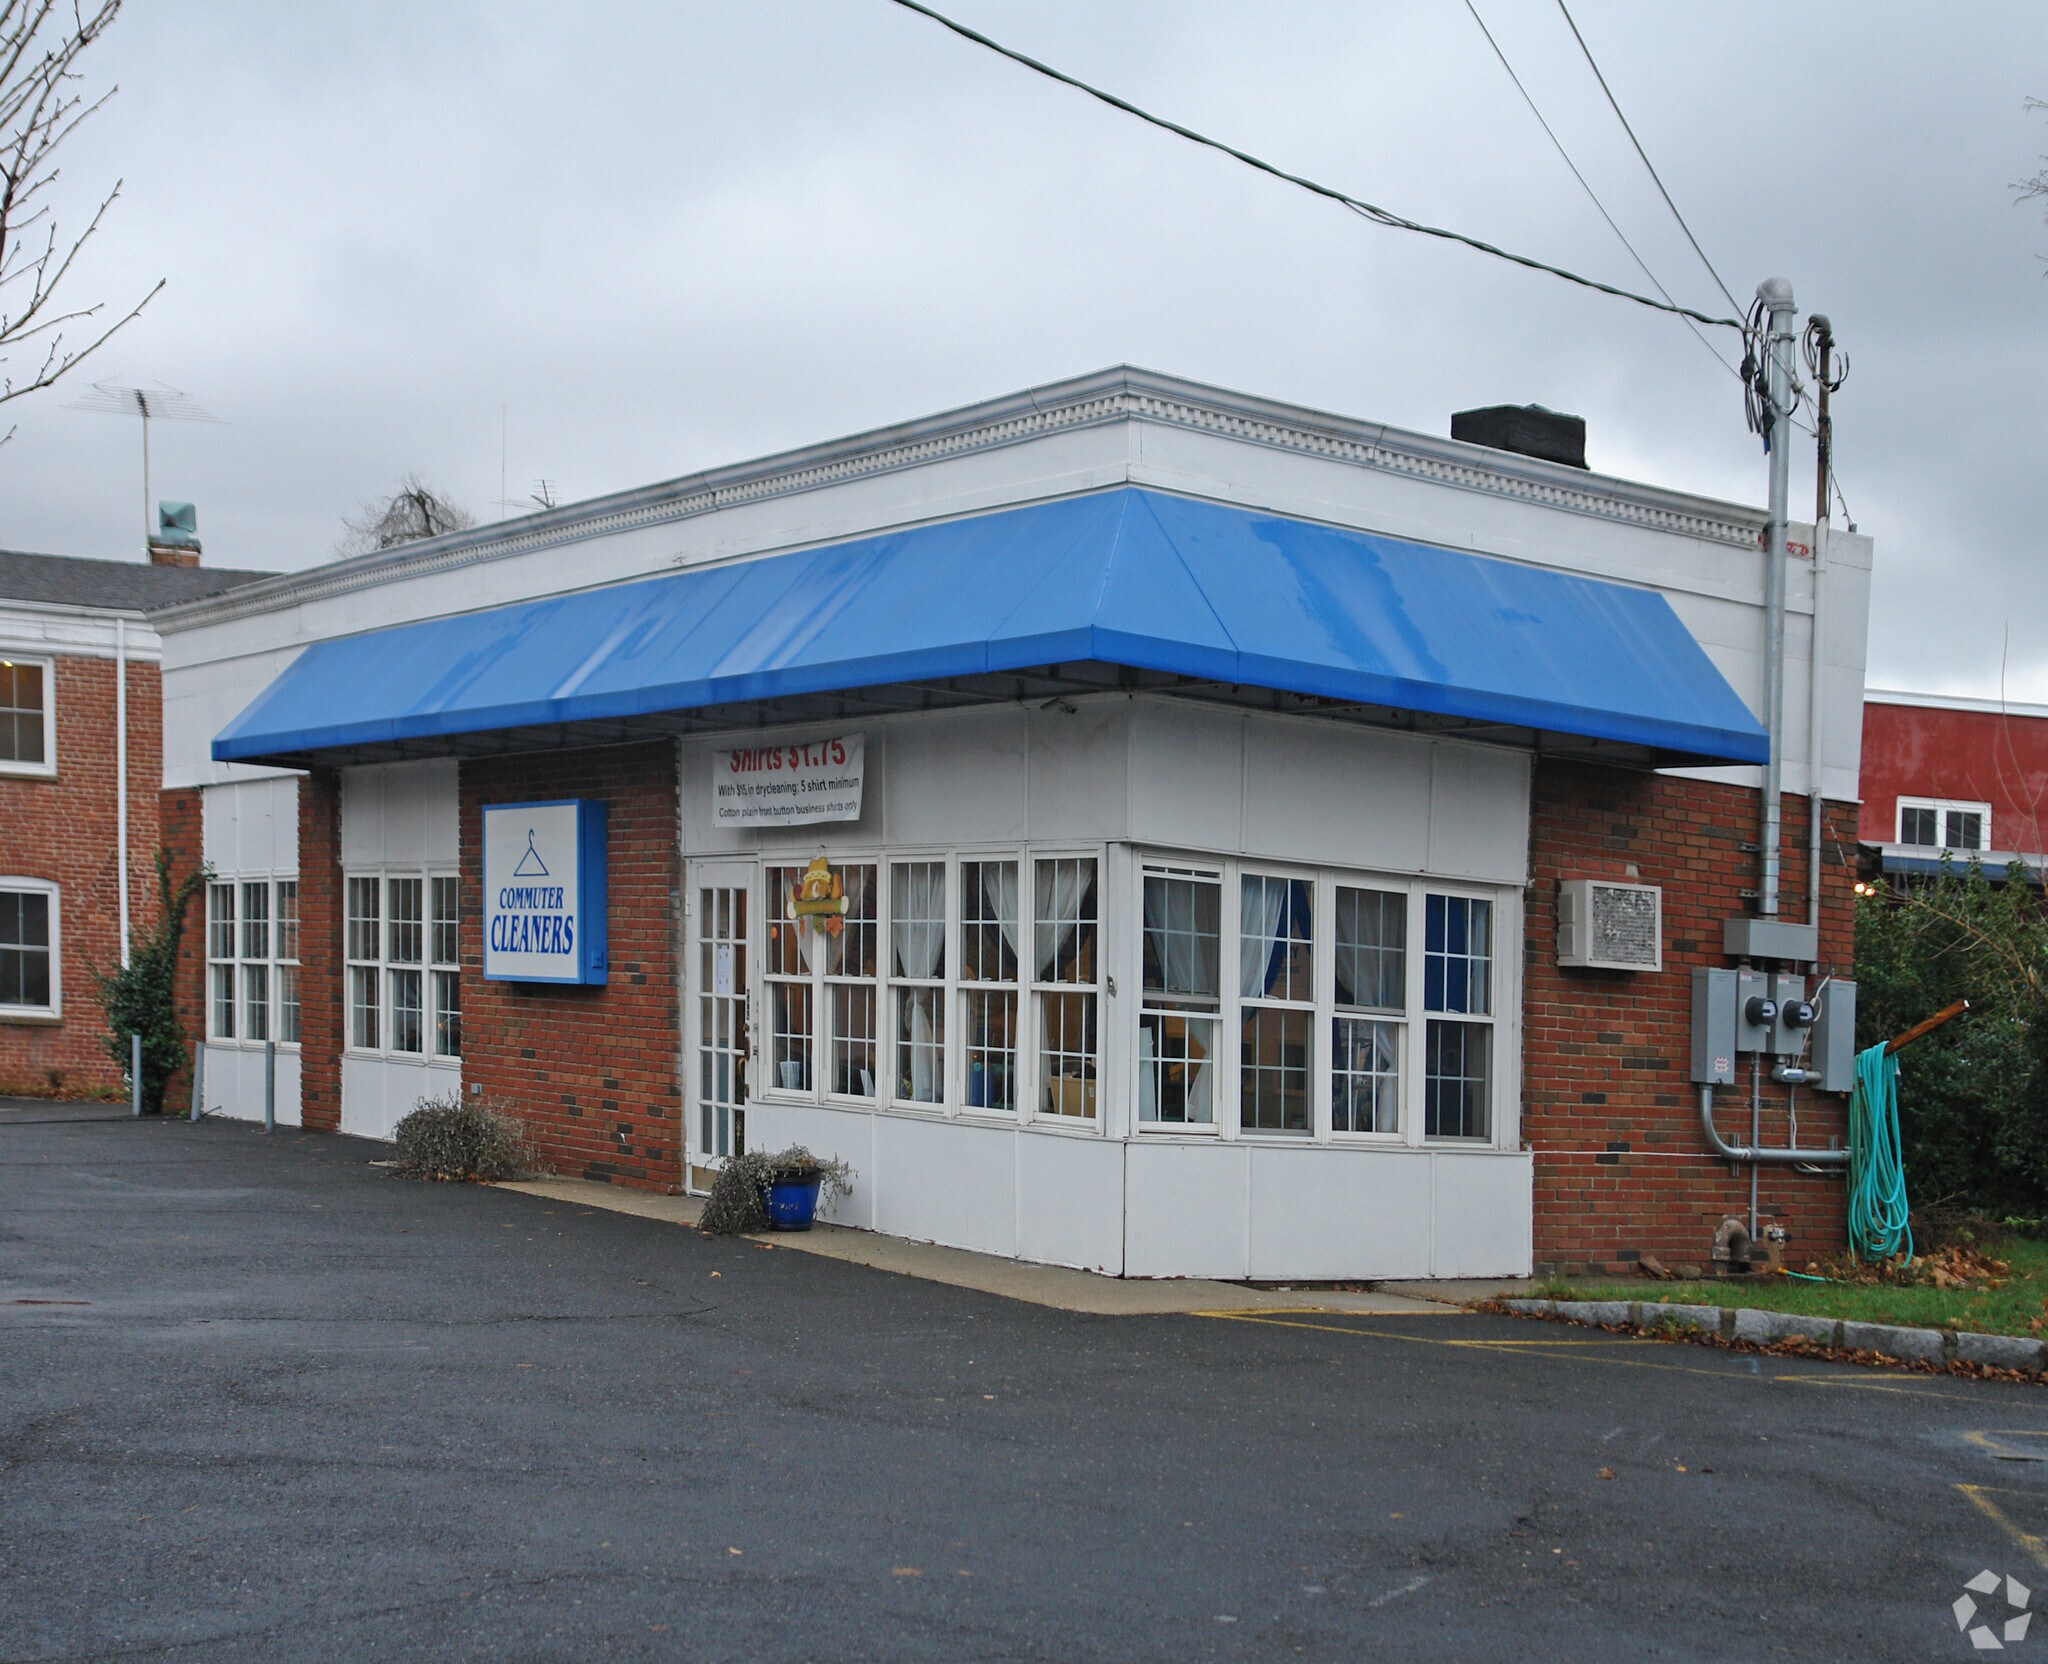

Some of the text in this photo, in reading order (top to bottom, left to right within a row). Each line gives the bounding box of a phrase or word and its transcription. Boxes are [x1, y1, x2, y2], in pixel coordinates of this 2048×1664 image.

[730, 737, 846, 773] Shirts $1.75
[718, 784, 735, 797] With
[747, 783, 754, 796] in
[801, 779, 806, 792] 5
[807, 779, 827, 792] shirt
[828, 776, 860, 790] minimum
[719, 807, 740, 818] Cotton
[741, 806, 758, 819] plain
[773, 805, 795, 816] button
[795, 803, 825, 815] business
[826, 801, 844, 812] shirts
[844, 799, 858, 813] only
[499, 887, 564, 910] COMMUTER
[491, 914, 574, 955] CLEANERS
